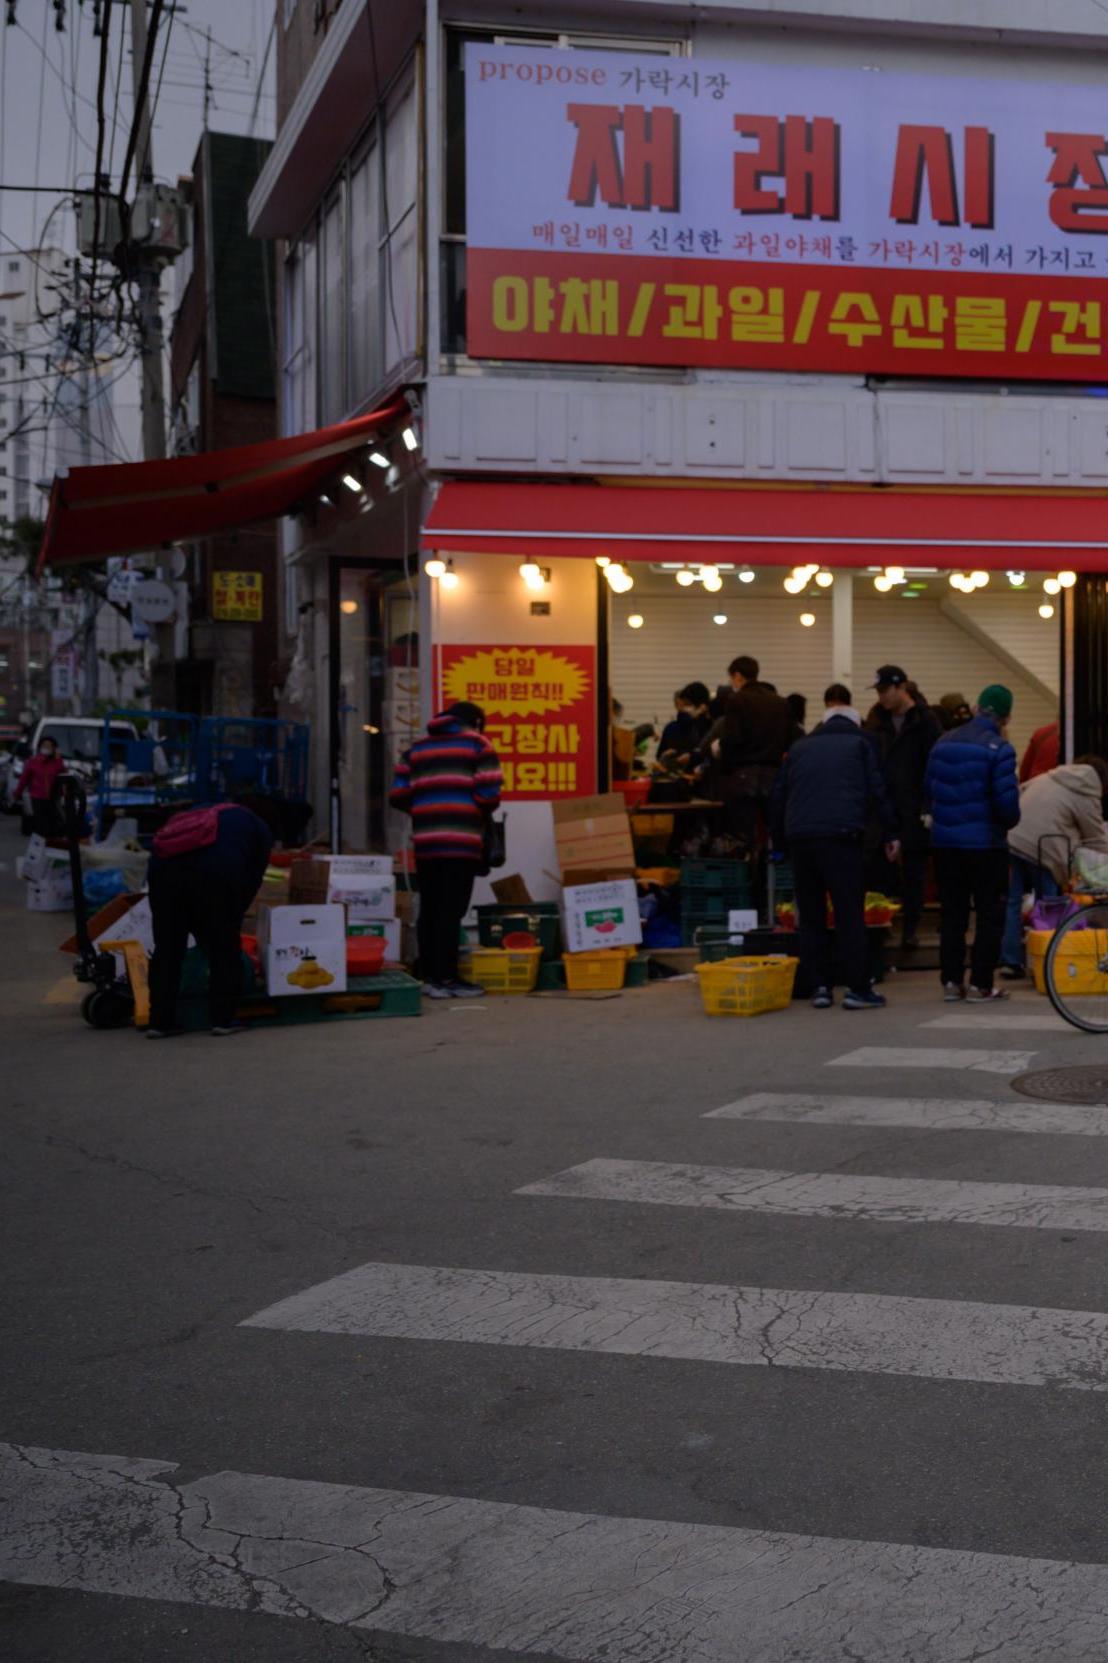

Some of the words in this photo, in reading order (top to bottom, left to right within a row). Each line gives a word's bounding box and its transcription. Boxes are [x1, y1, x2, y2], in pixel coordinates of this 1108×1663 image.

[478, 58, 607, 86] propose
[619, 67, 731, 100] 가락시장
[532, 221, 634, 250] 매일매일
[647, 227, 722, 254] 신선한
[732, 232, 857, 264] 과일야채를
[868, 238, 1014, 268] 가락시장에서
[1025, 246, 1096, 271] 가지고
[485, 723, 581, 755] 고장사
